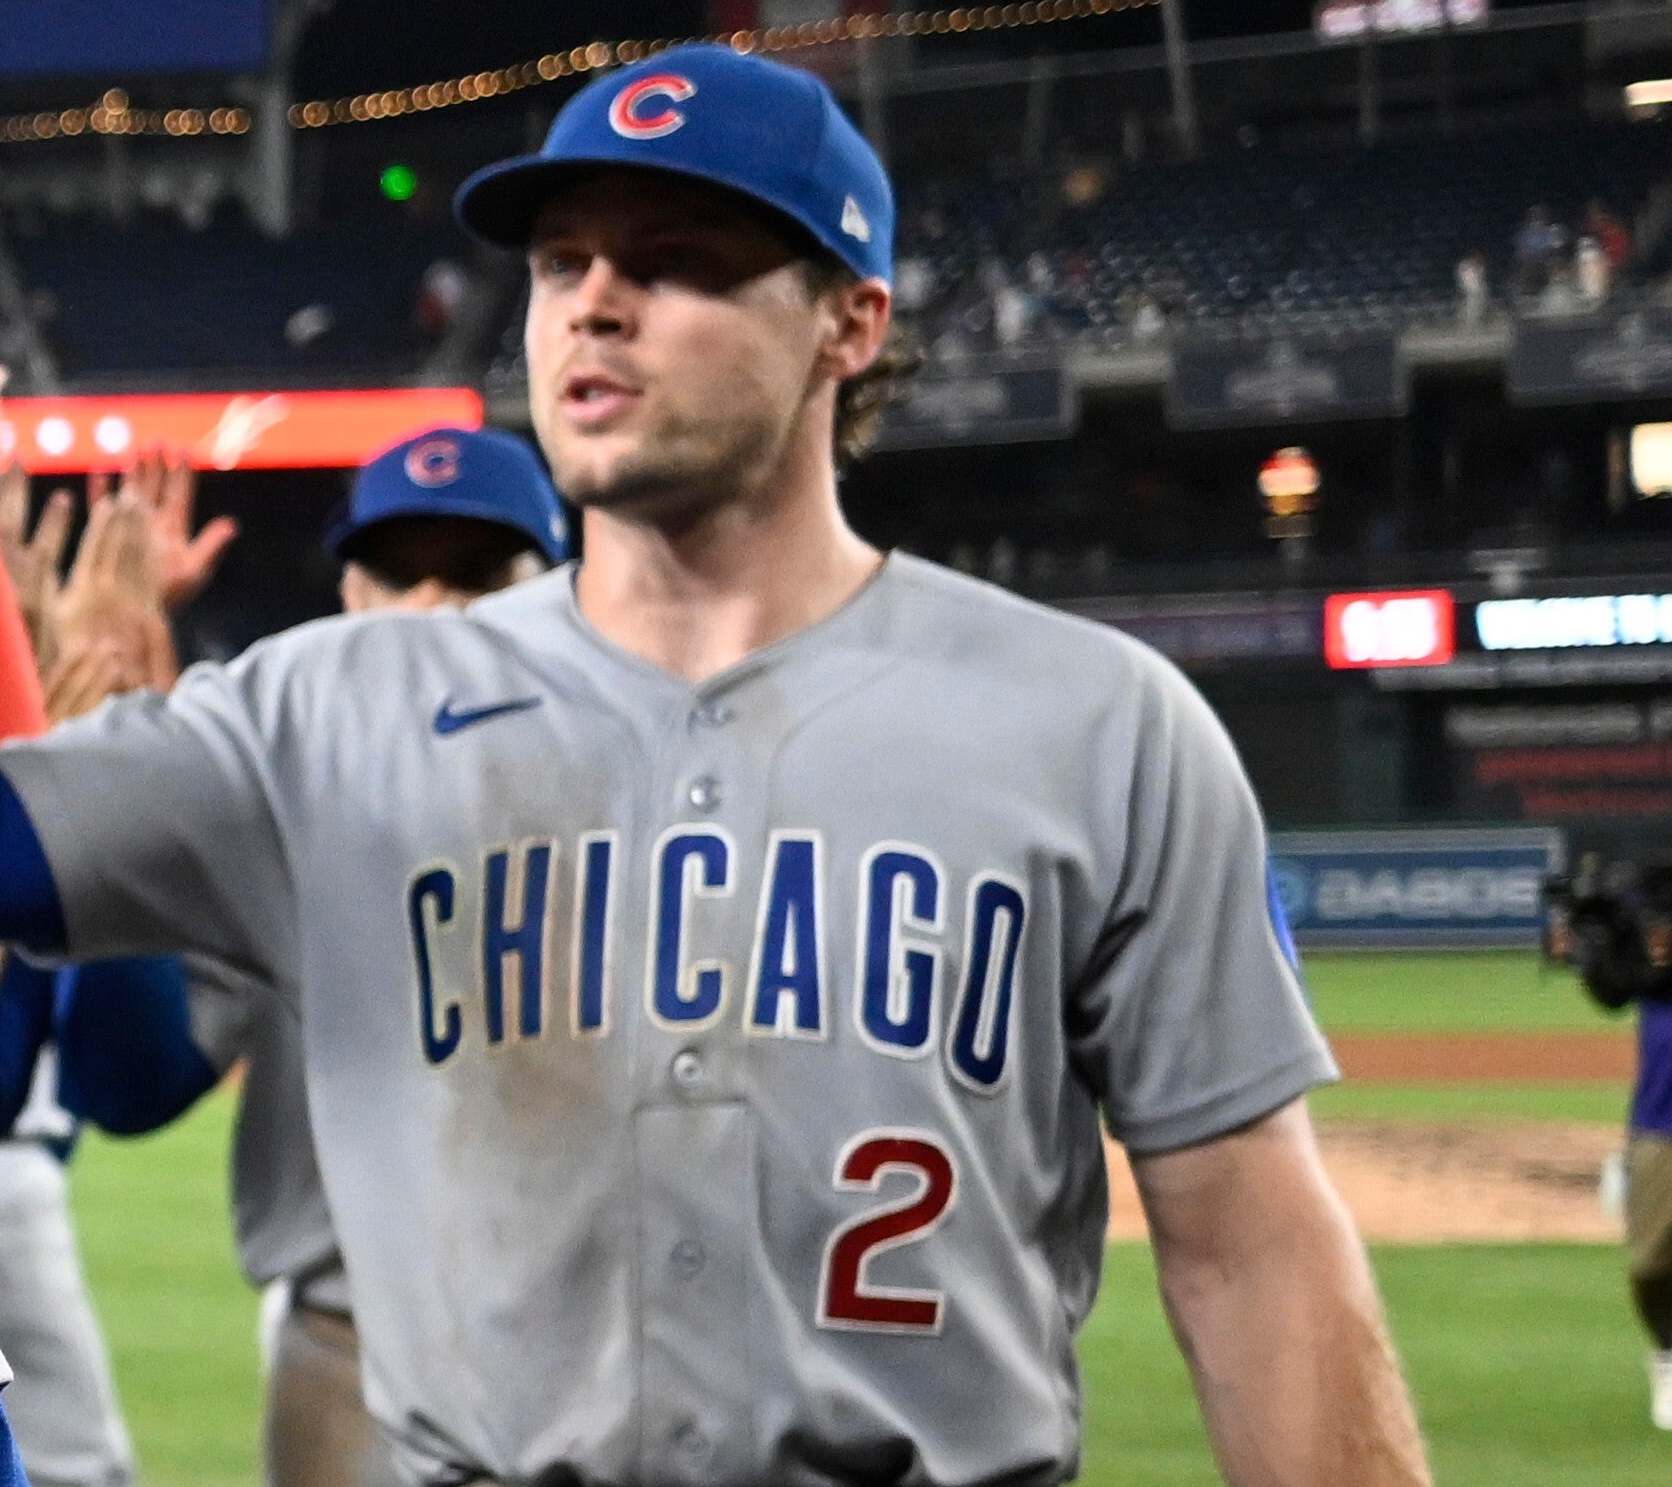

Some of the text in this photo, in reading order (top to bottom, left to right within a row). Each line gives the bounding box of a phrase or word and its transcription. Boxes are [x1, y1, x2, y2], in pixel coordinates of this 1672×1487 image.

[609, 72, 698, 139] C
[404, 437, 461, 489] C
[408, 823, 1027, 1096] CHICAGO
[816, 1127, 959, 1337] 2
